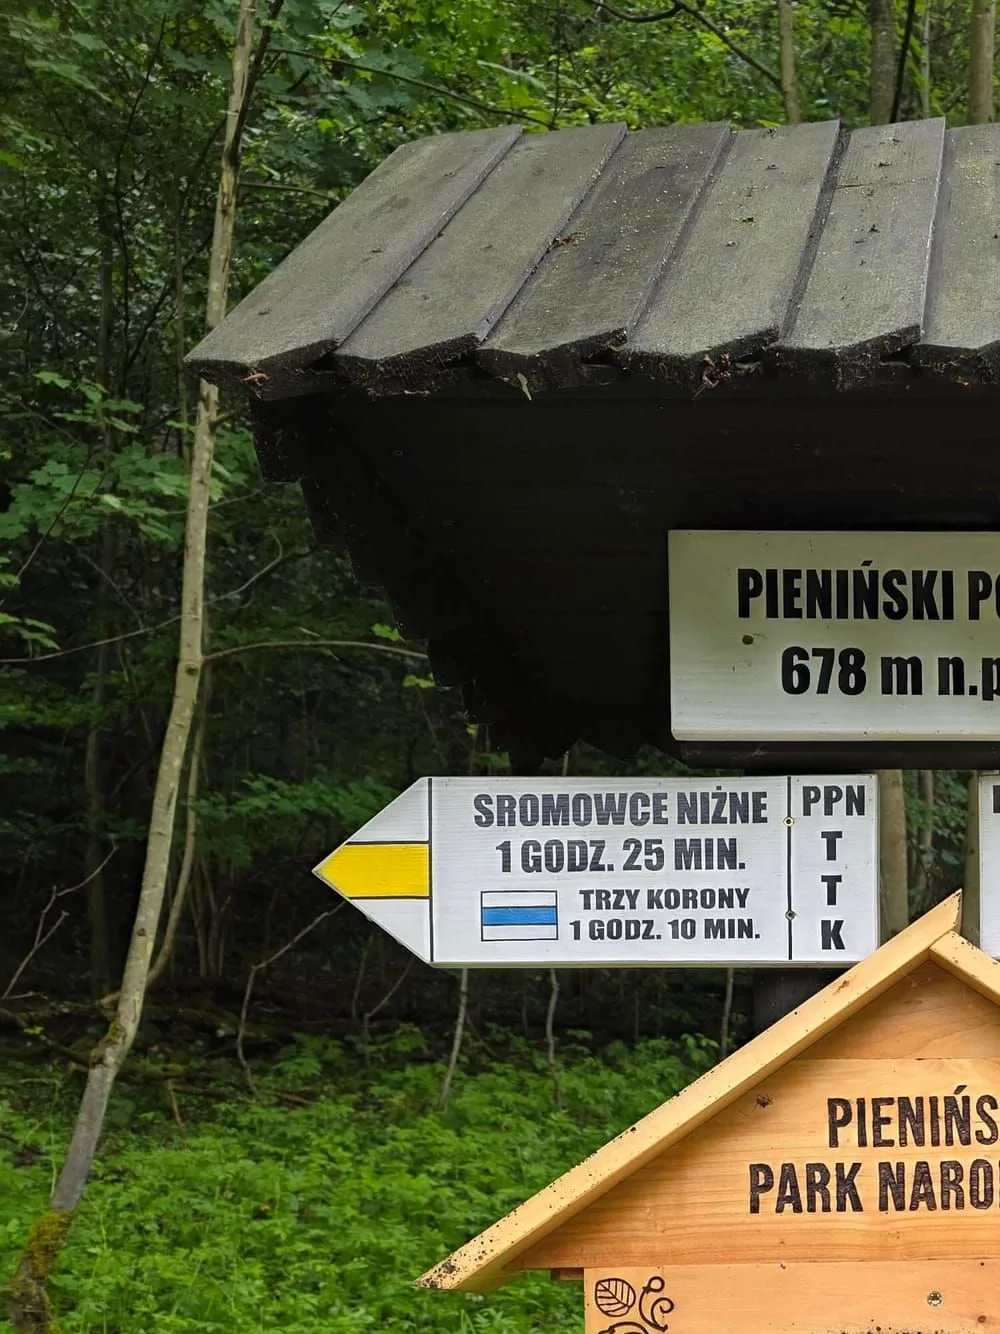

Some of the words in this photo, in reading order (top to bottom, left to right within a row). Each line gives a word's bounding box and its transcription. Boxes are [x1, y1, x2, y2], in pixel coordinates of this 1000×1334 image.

[738, 560, 954, 621] PIENIŃSKI
[782, 646, 866, 695] 678
[880, 656, 922, 695] m
[474, 793, 668, 827] SROMOWCE
[678, 788, 767, 824] NIŻNE
[803, 786, 865, 816] PPN
[496, 841, 510, 872] 1
[522, 840, 613, 873] GODZ.
[623, 838, 664, 871] 25
[675, 838, 745, 870] MIN.
[822, 831, 842, 860] T
[580, 890, 640, 909] TRZY
[648, 888, 749, 909] KORONY
[822, 875, 842, 905] T
[570, 921, 580, 940] 1
[589, 919, 661, 940] GODZ.
[668, 919, 695, 939] 10
[705, 919, 760, 938] MIN.
[822, 920, 845, 949] K
[750, 1163, 863, 1213] PARK
